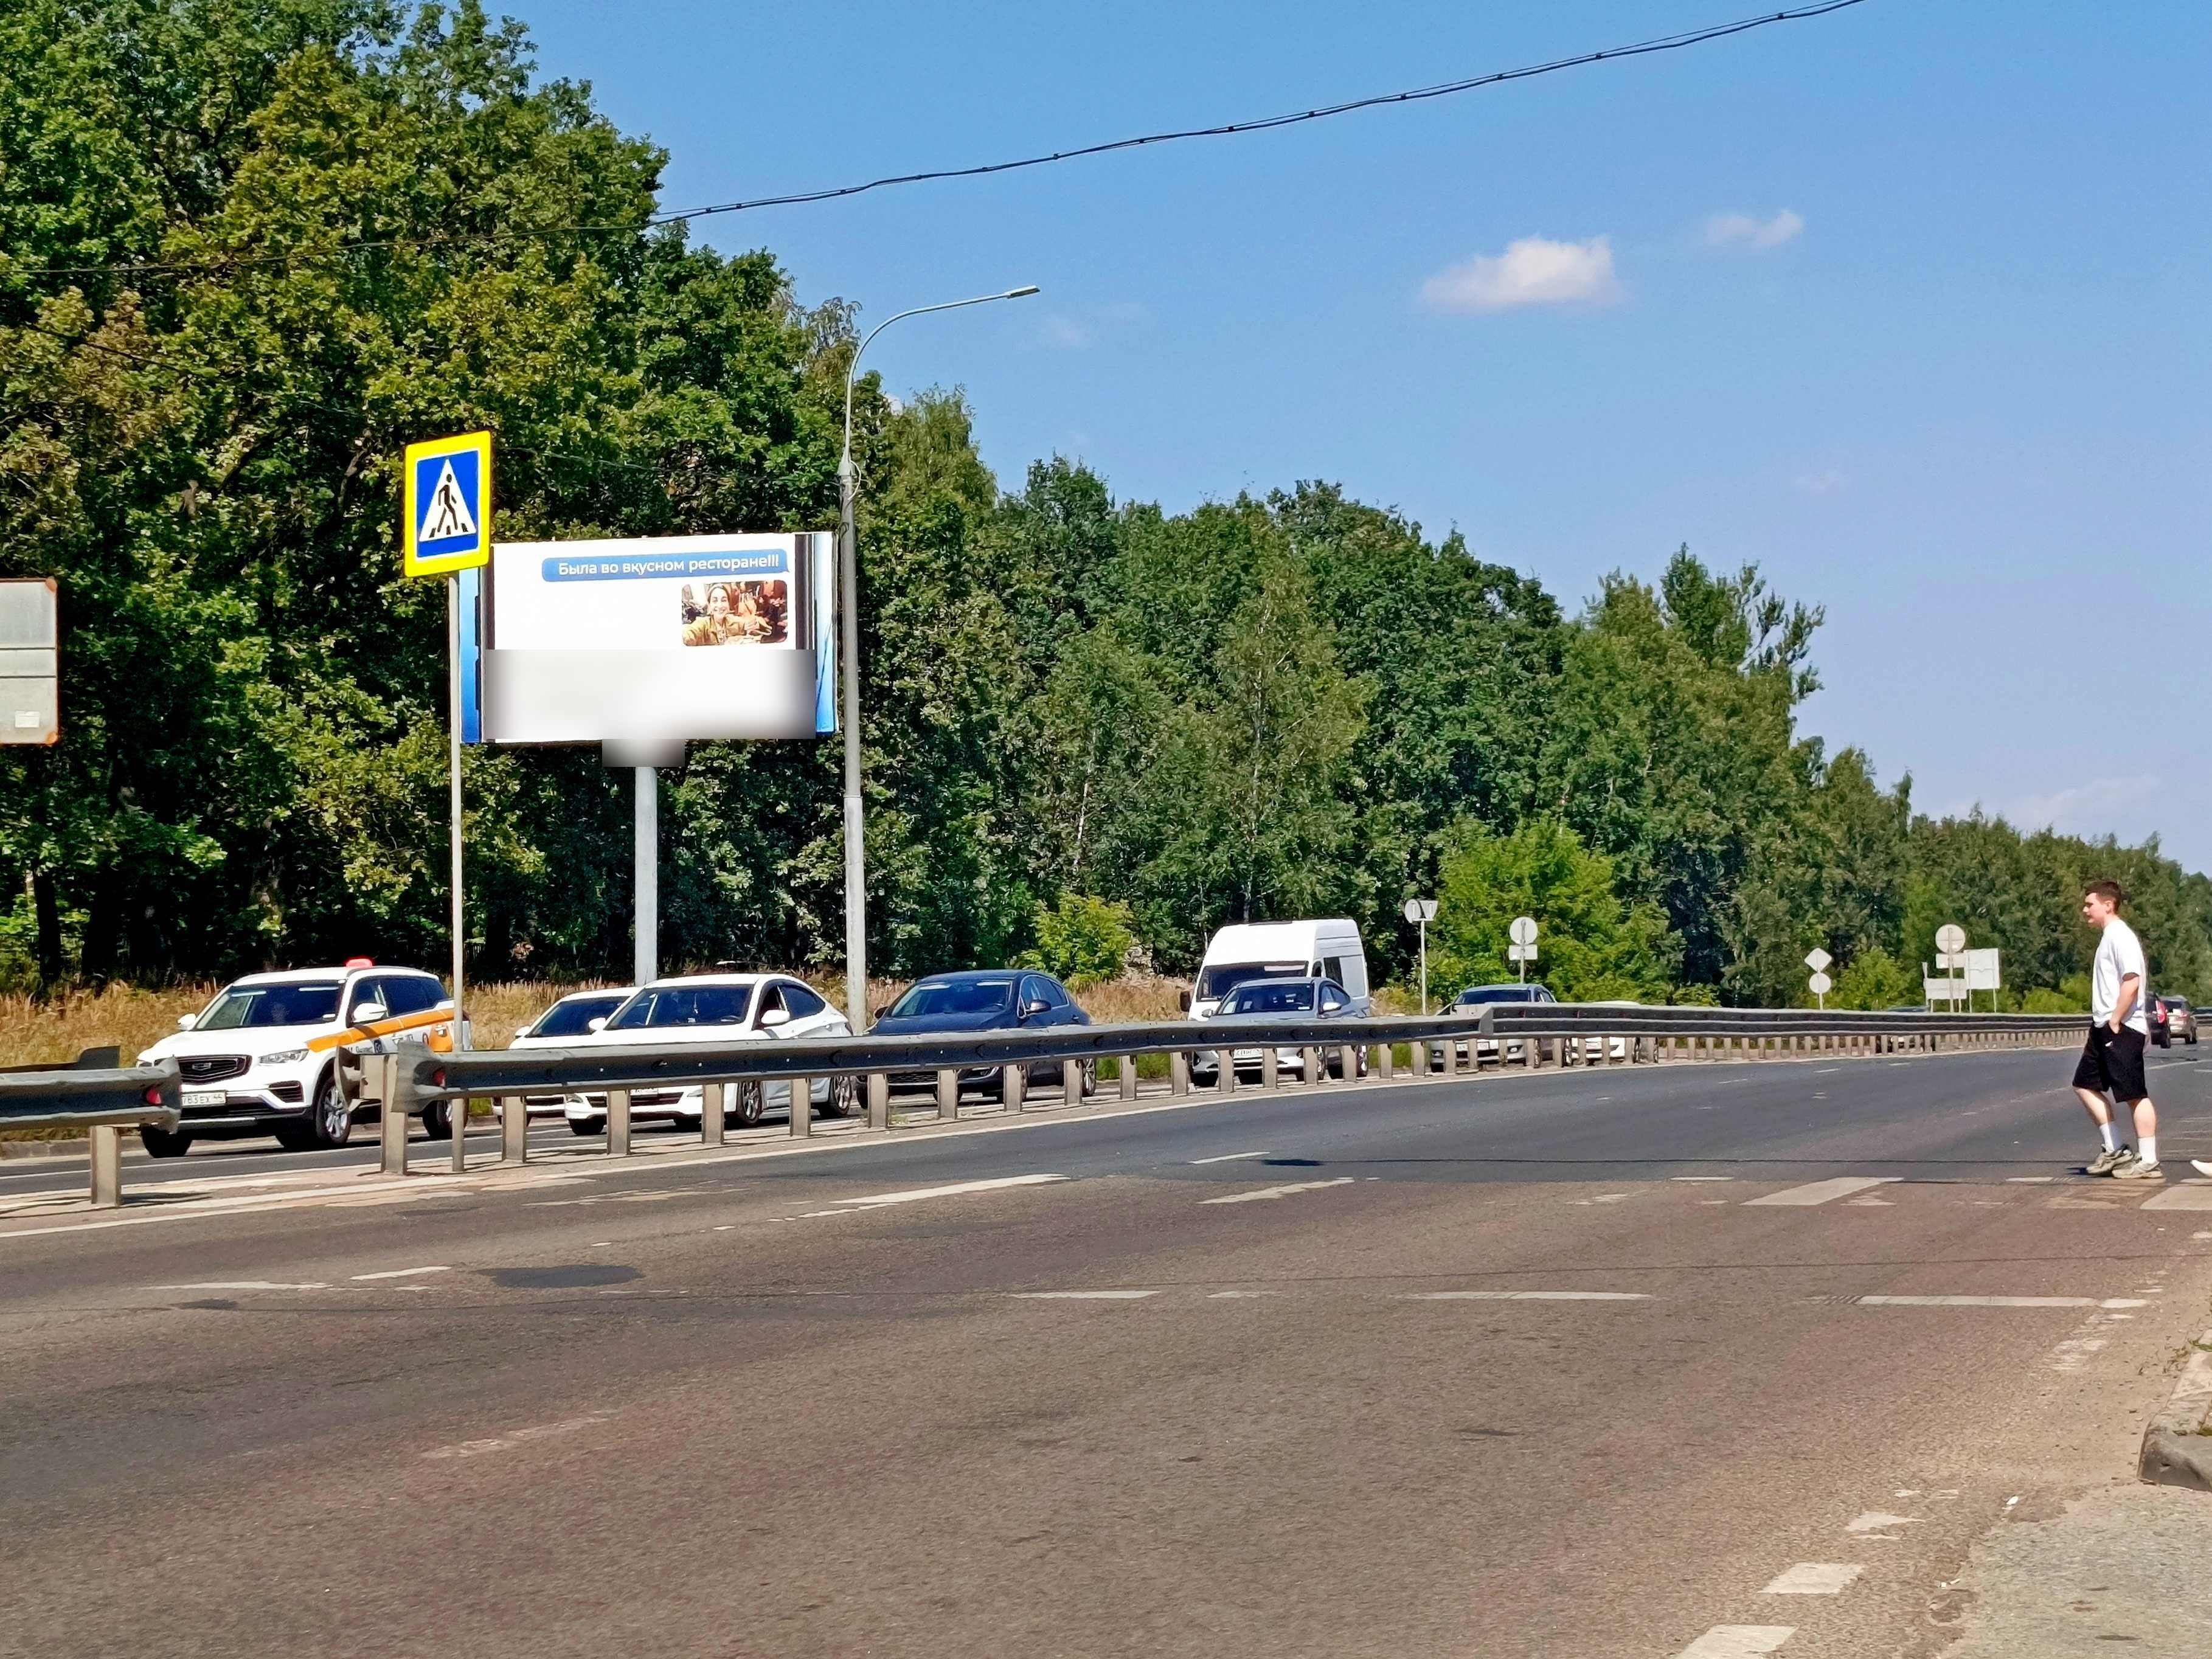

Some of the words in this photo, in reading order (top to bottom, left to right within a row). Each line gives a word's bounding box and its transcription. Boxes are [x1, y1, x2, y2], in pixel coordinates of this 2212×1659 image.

[558, 563, 597, 575] Была
[602, 563, 619, 573] во
[623, 560, 685, 575] вкусном
[688, 554, 779, 573] ресторане!!!
